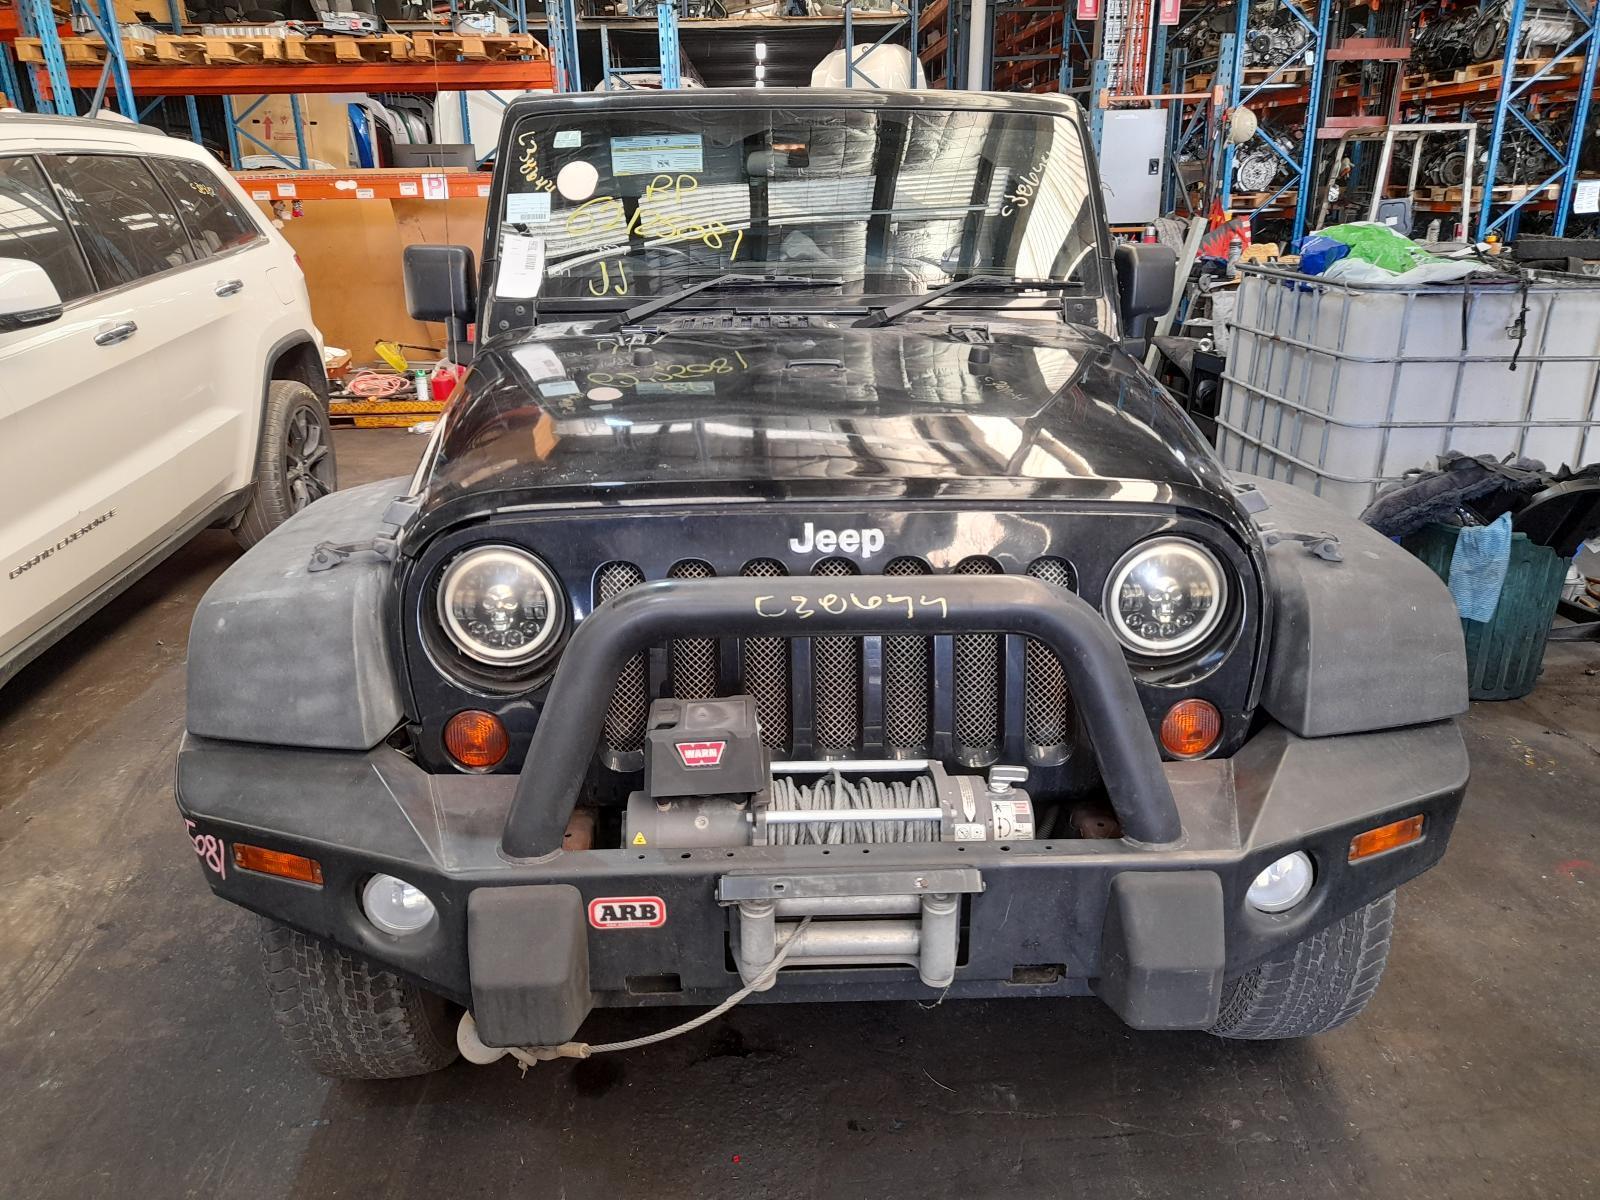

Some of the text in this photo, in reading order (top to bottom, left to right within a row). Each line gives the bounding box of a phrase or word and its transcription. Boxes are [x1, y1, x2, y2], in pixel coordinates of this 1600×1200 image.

[646, 174, 699, 203] RP
[789, 522, 885, 558] Jeep
[600, 904, 657, 921] ARB
